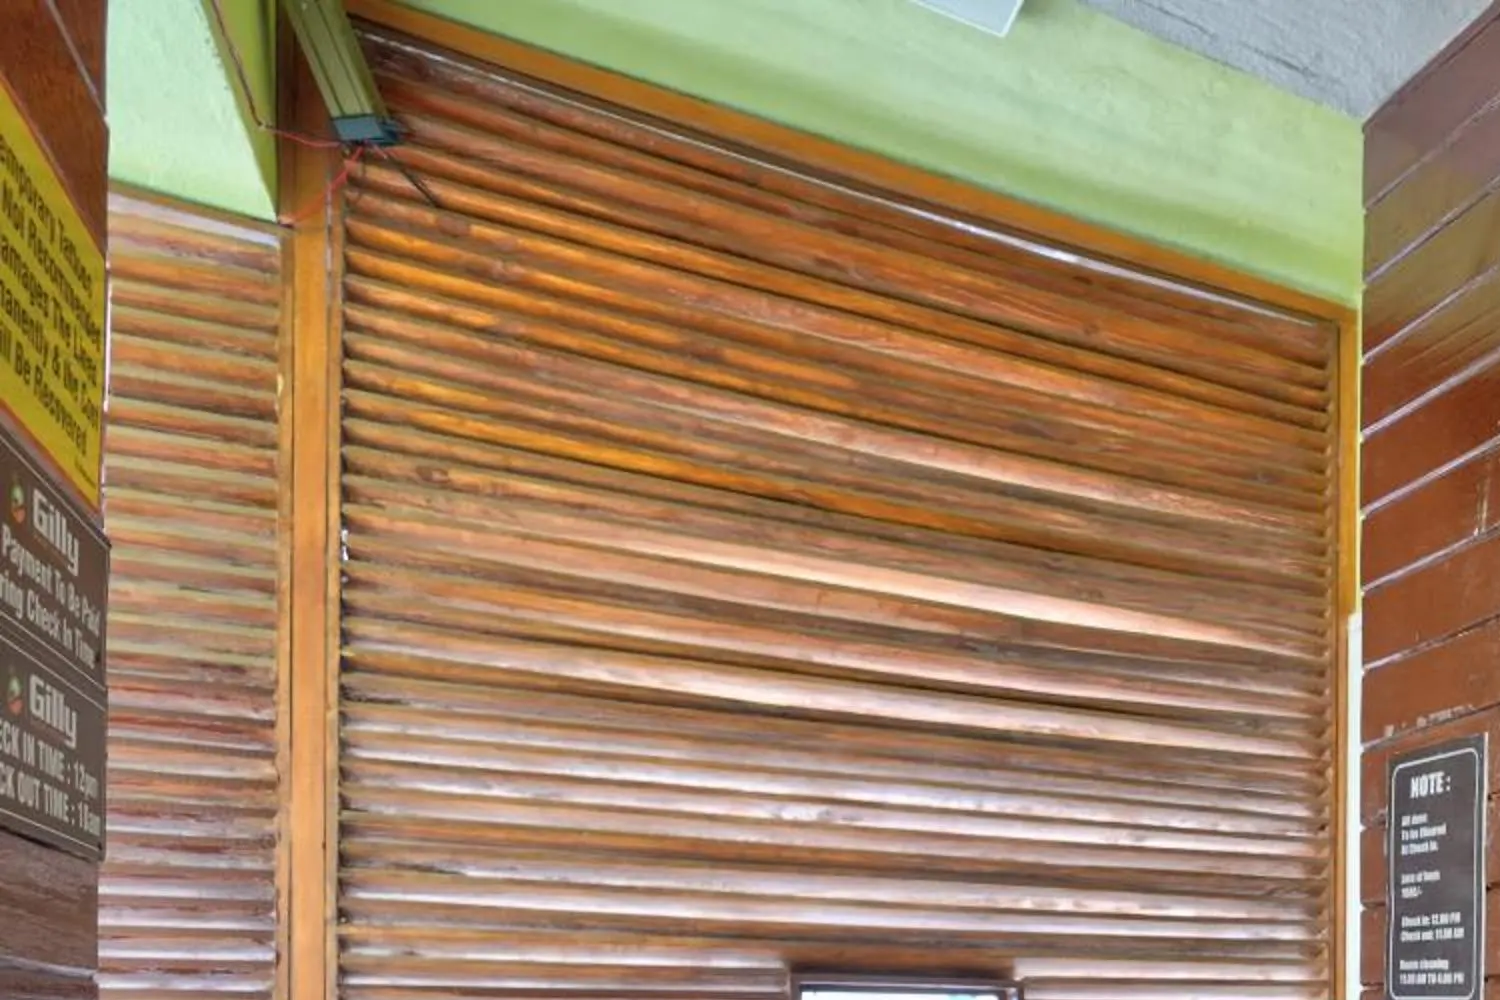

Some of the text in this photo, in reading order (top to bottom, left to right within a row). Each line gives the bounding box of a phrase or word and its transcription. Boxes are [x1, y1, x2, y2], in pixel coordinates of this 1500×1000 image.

[15, 341, 31, 385] Be
[32, 488, 79, 577] Gilly
[2, 523, 52, 595] Payment
[54, 571, 66, 605] To
[67, 582, 80, 617] Be
[27, 589, 61, 642] Check
[29, 674, 77, 749] Gilly
[23, 732, 35, 767] IN
[38, 741, 64, 781] TIME
[18, 772, 40, 810] OUT
[44, 783, 68, 822] TIME
